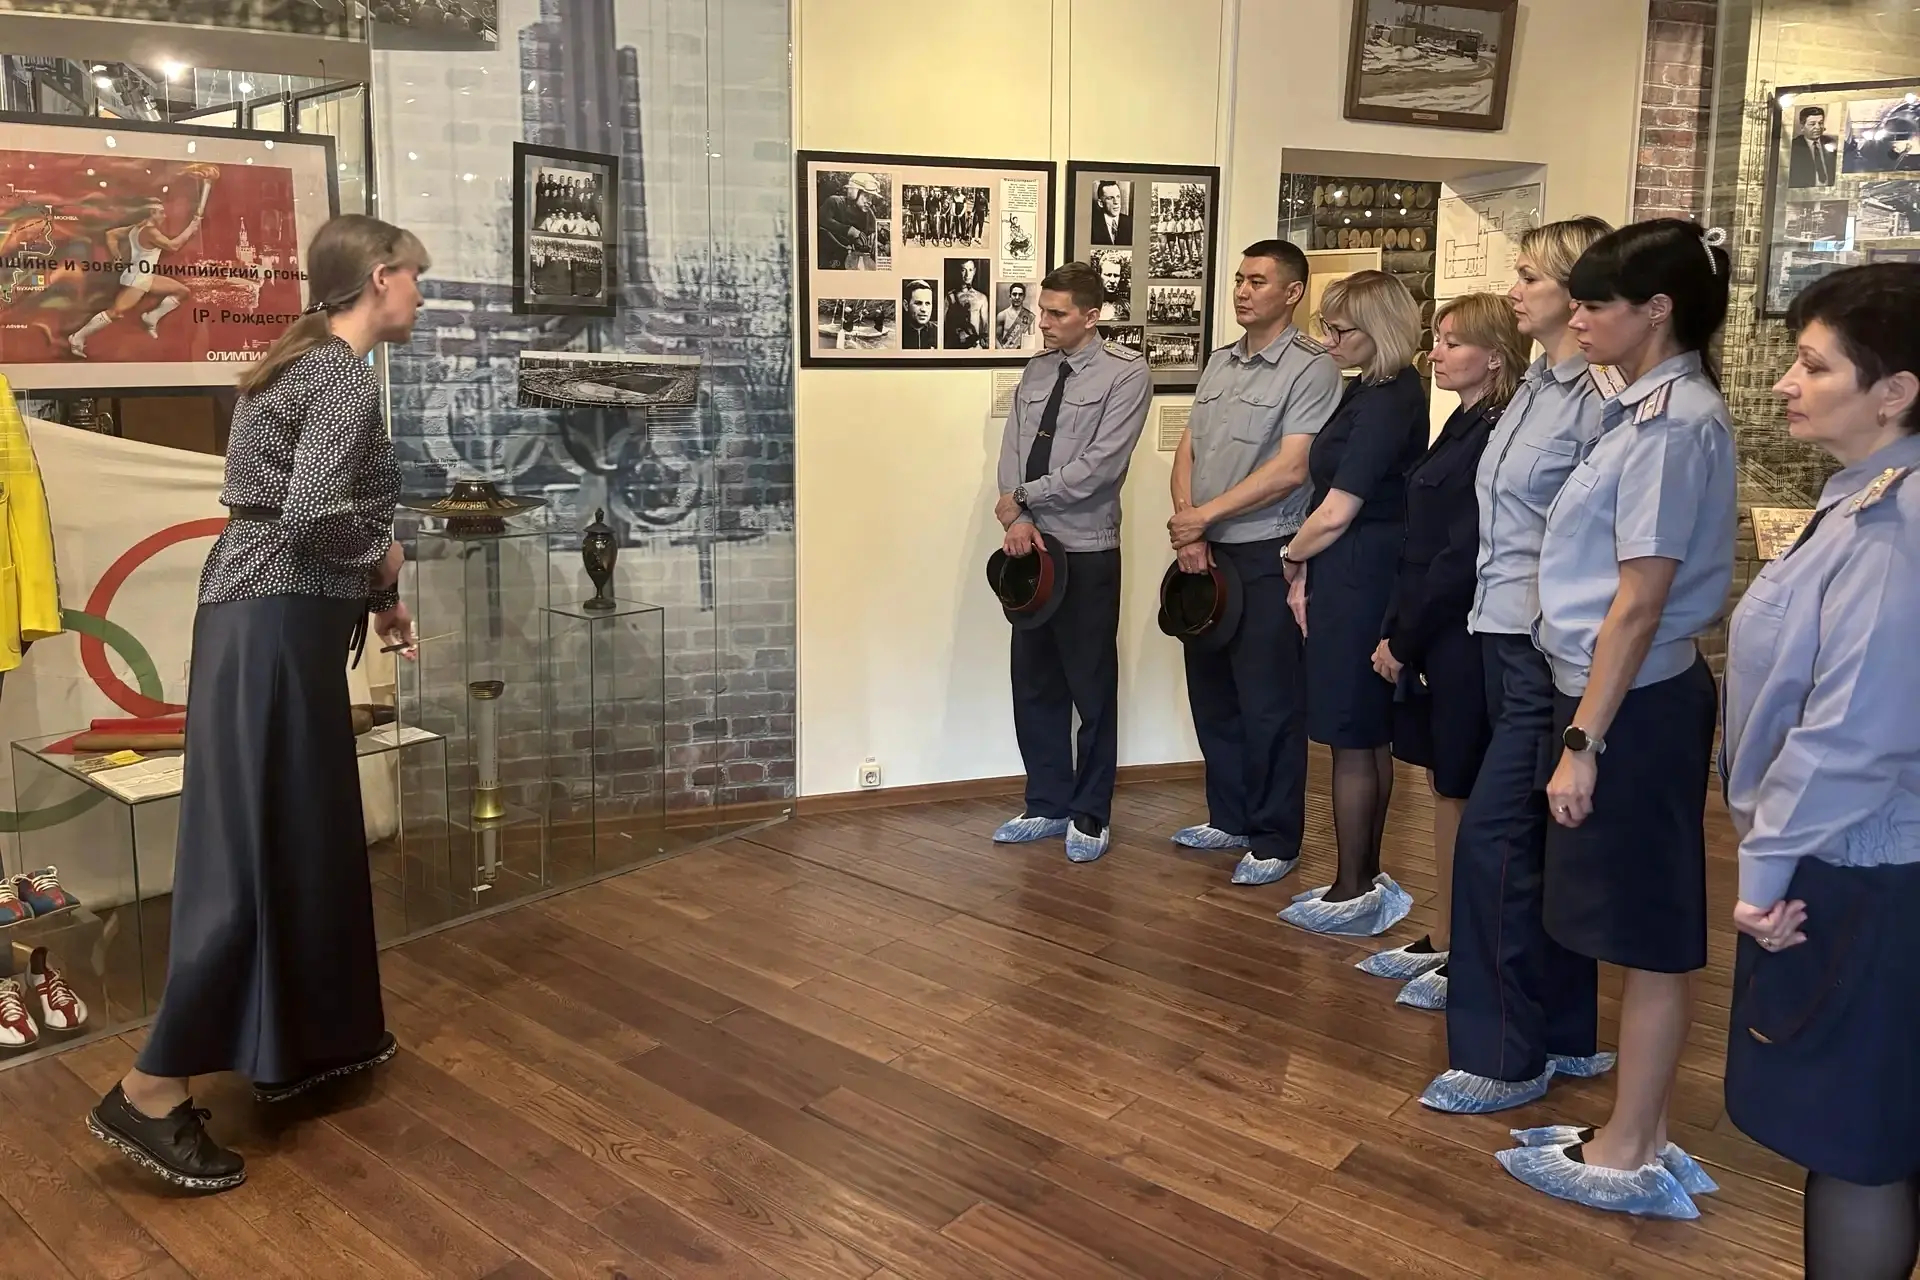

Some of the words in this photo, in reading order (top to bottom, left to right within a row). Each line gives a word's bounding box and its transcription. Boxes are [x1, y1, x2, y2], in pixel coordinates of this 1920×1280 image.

[0, 257, 58, 270] шине
[64, 259, 76, 271] и
[81, 258, 134, 273] зовёт
[138, 259, 259, 279] Олимпийский
[264, 269, 308, 281] огонь
